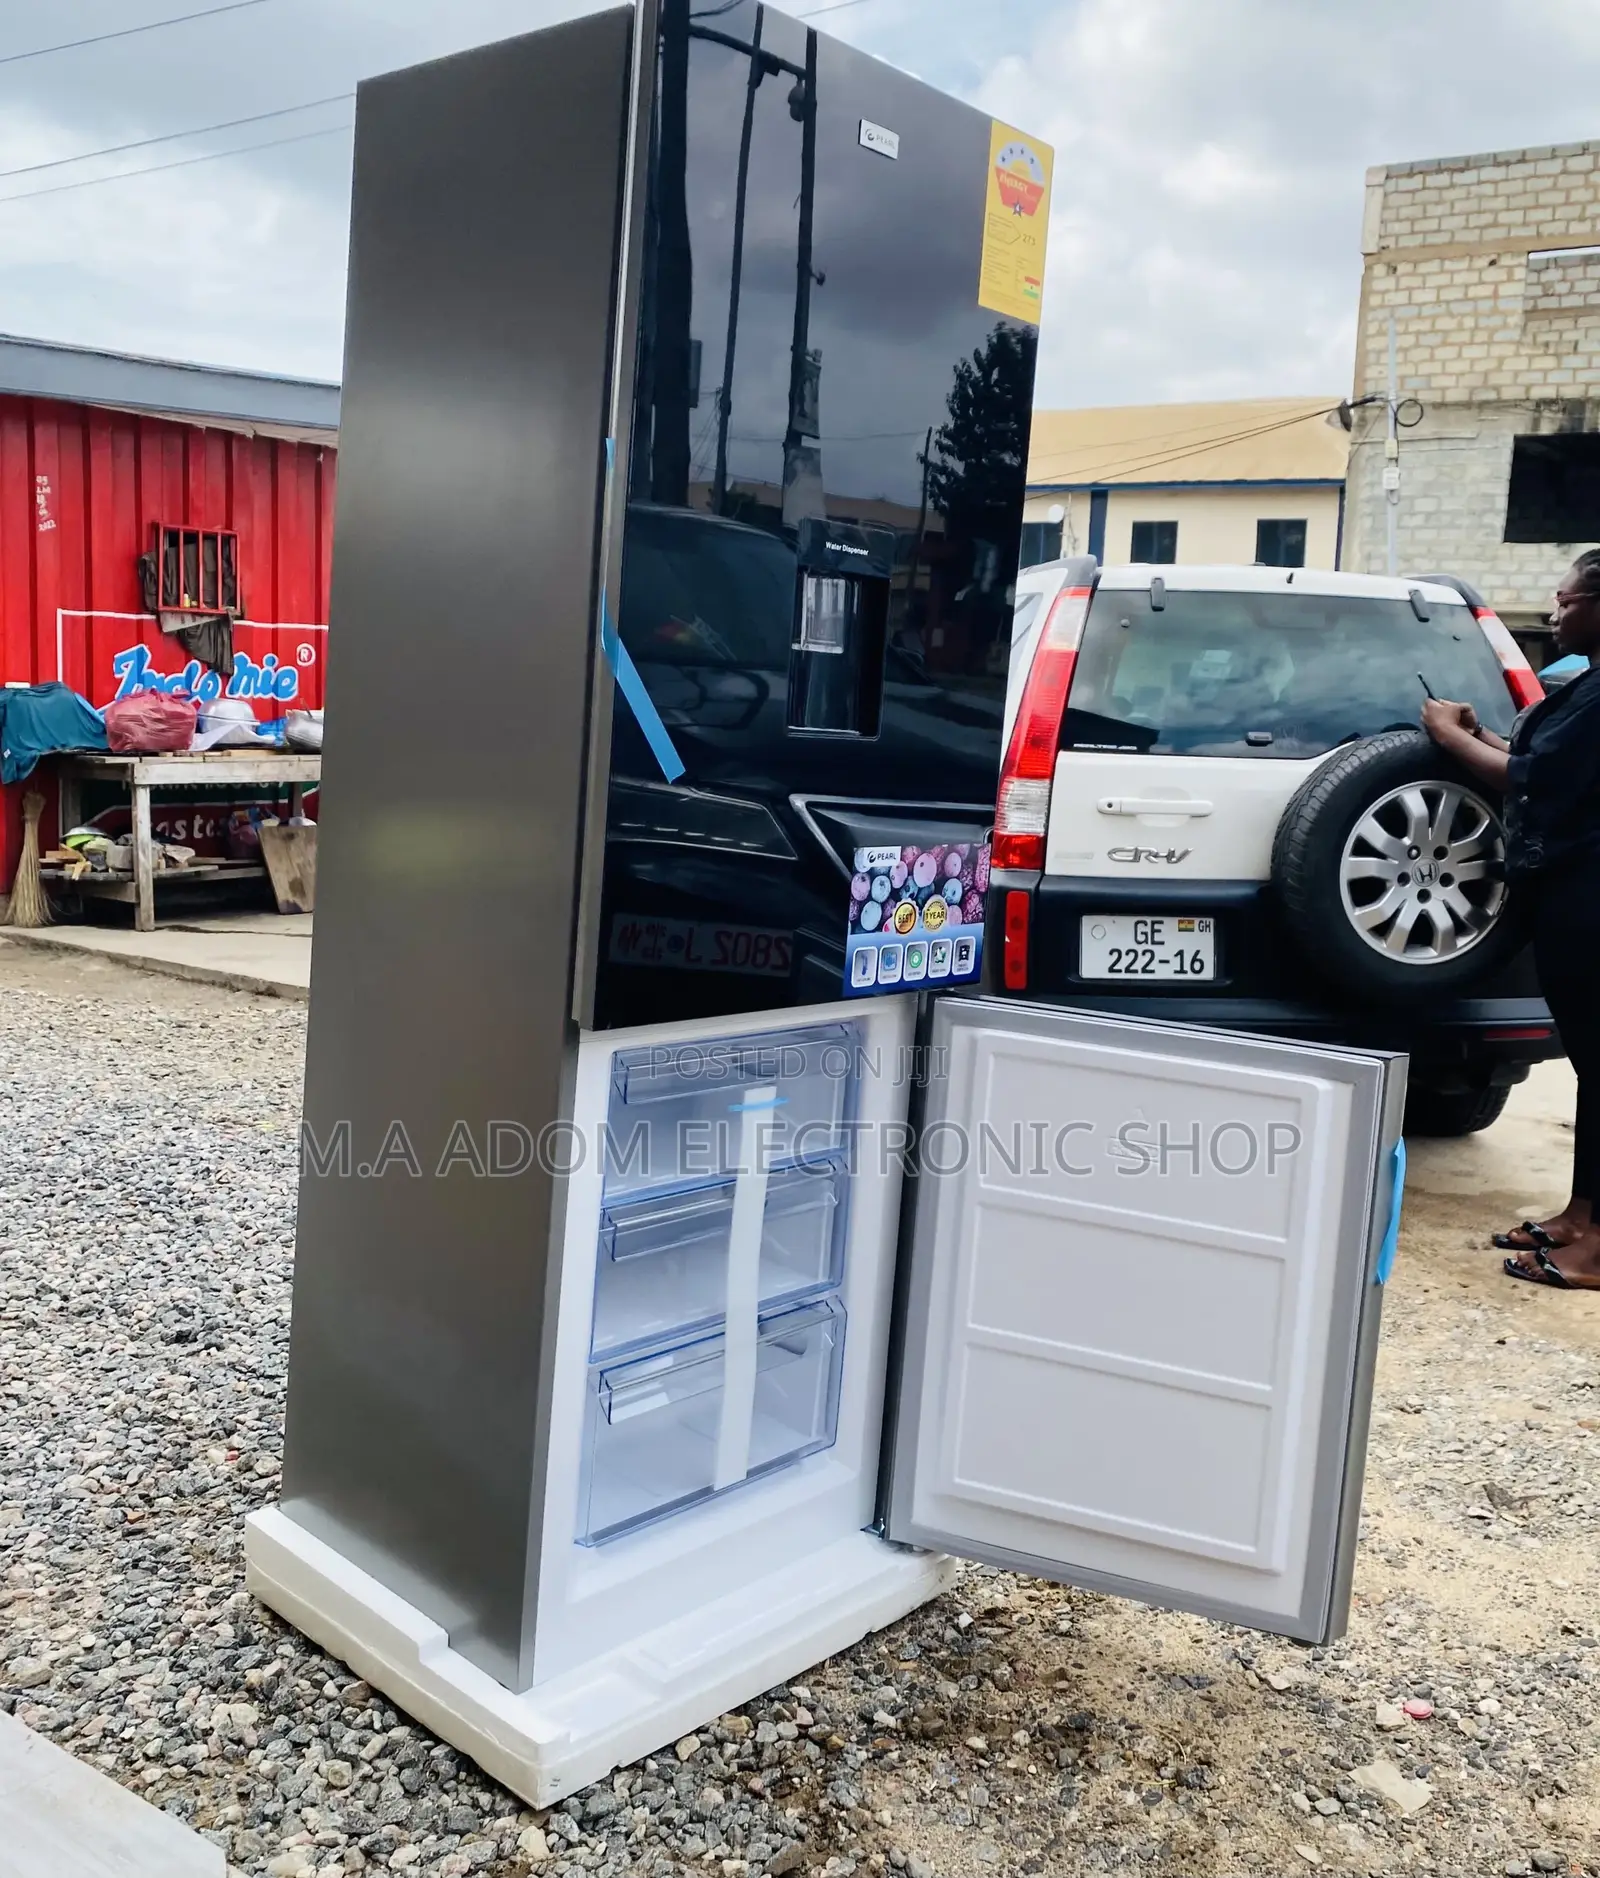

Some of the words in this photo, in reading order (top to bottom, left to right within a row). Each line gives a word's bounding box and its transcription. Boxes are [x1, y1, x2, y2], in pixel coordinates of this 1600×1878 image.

[825, 541, 842, 551] Water
[842, 544, 869, 556] Dispenser
[877, 852, 897, 861] PEARL
[898, 912, 914, 924] BEST
[929, 911, 945, 920] YEAR
[1133, 919, 1166, 946] GE
[1198, 919, 1212, 933] GH
[1107, 947, 1205, 975] 222-16
